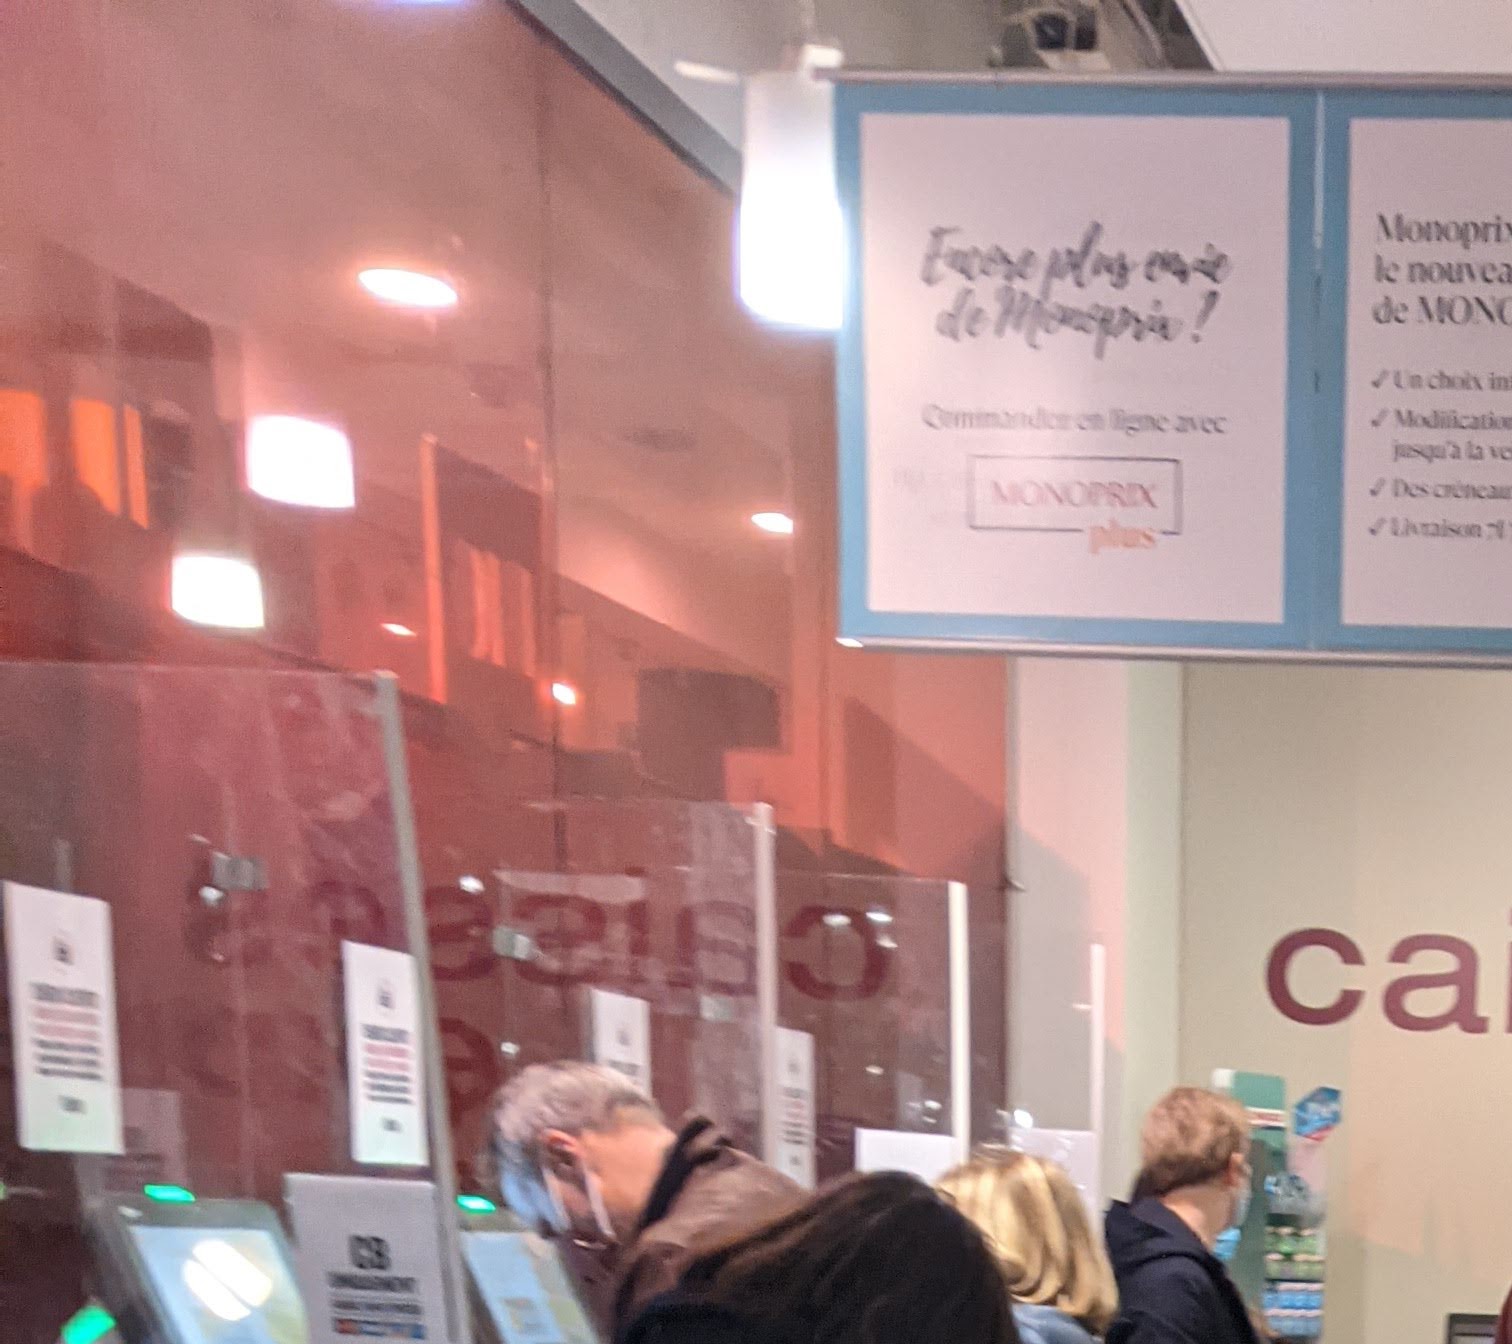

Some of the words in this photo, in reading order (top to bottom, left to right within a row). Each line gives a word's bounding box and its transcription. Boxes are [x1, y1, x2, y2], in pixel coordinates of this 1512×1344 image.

[1374, 252, 1400, 283] le
[1373, 296, 1409, 324] de
[1393, 370, 1424, 390] Un
[1428, 370, 1482, 391] choix
[1174, 415, 1227, 434] avec
[1467, 441, 1484, 460] la
[990, 481, 1158, 509] MONOPRIX
[1391, 517, 1482, 538] Livraison
